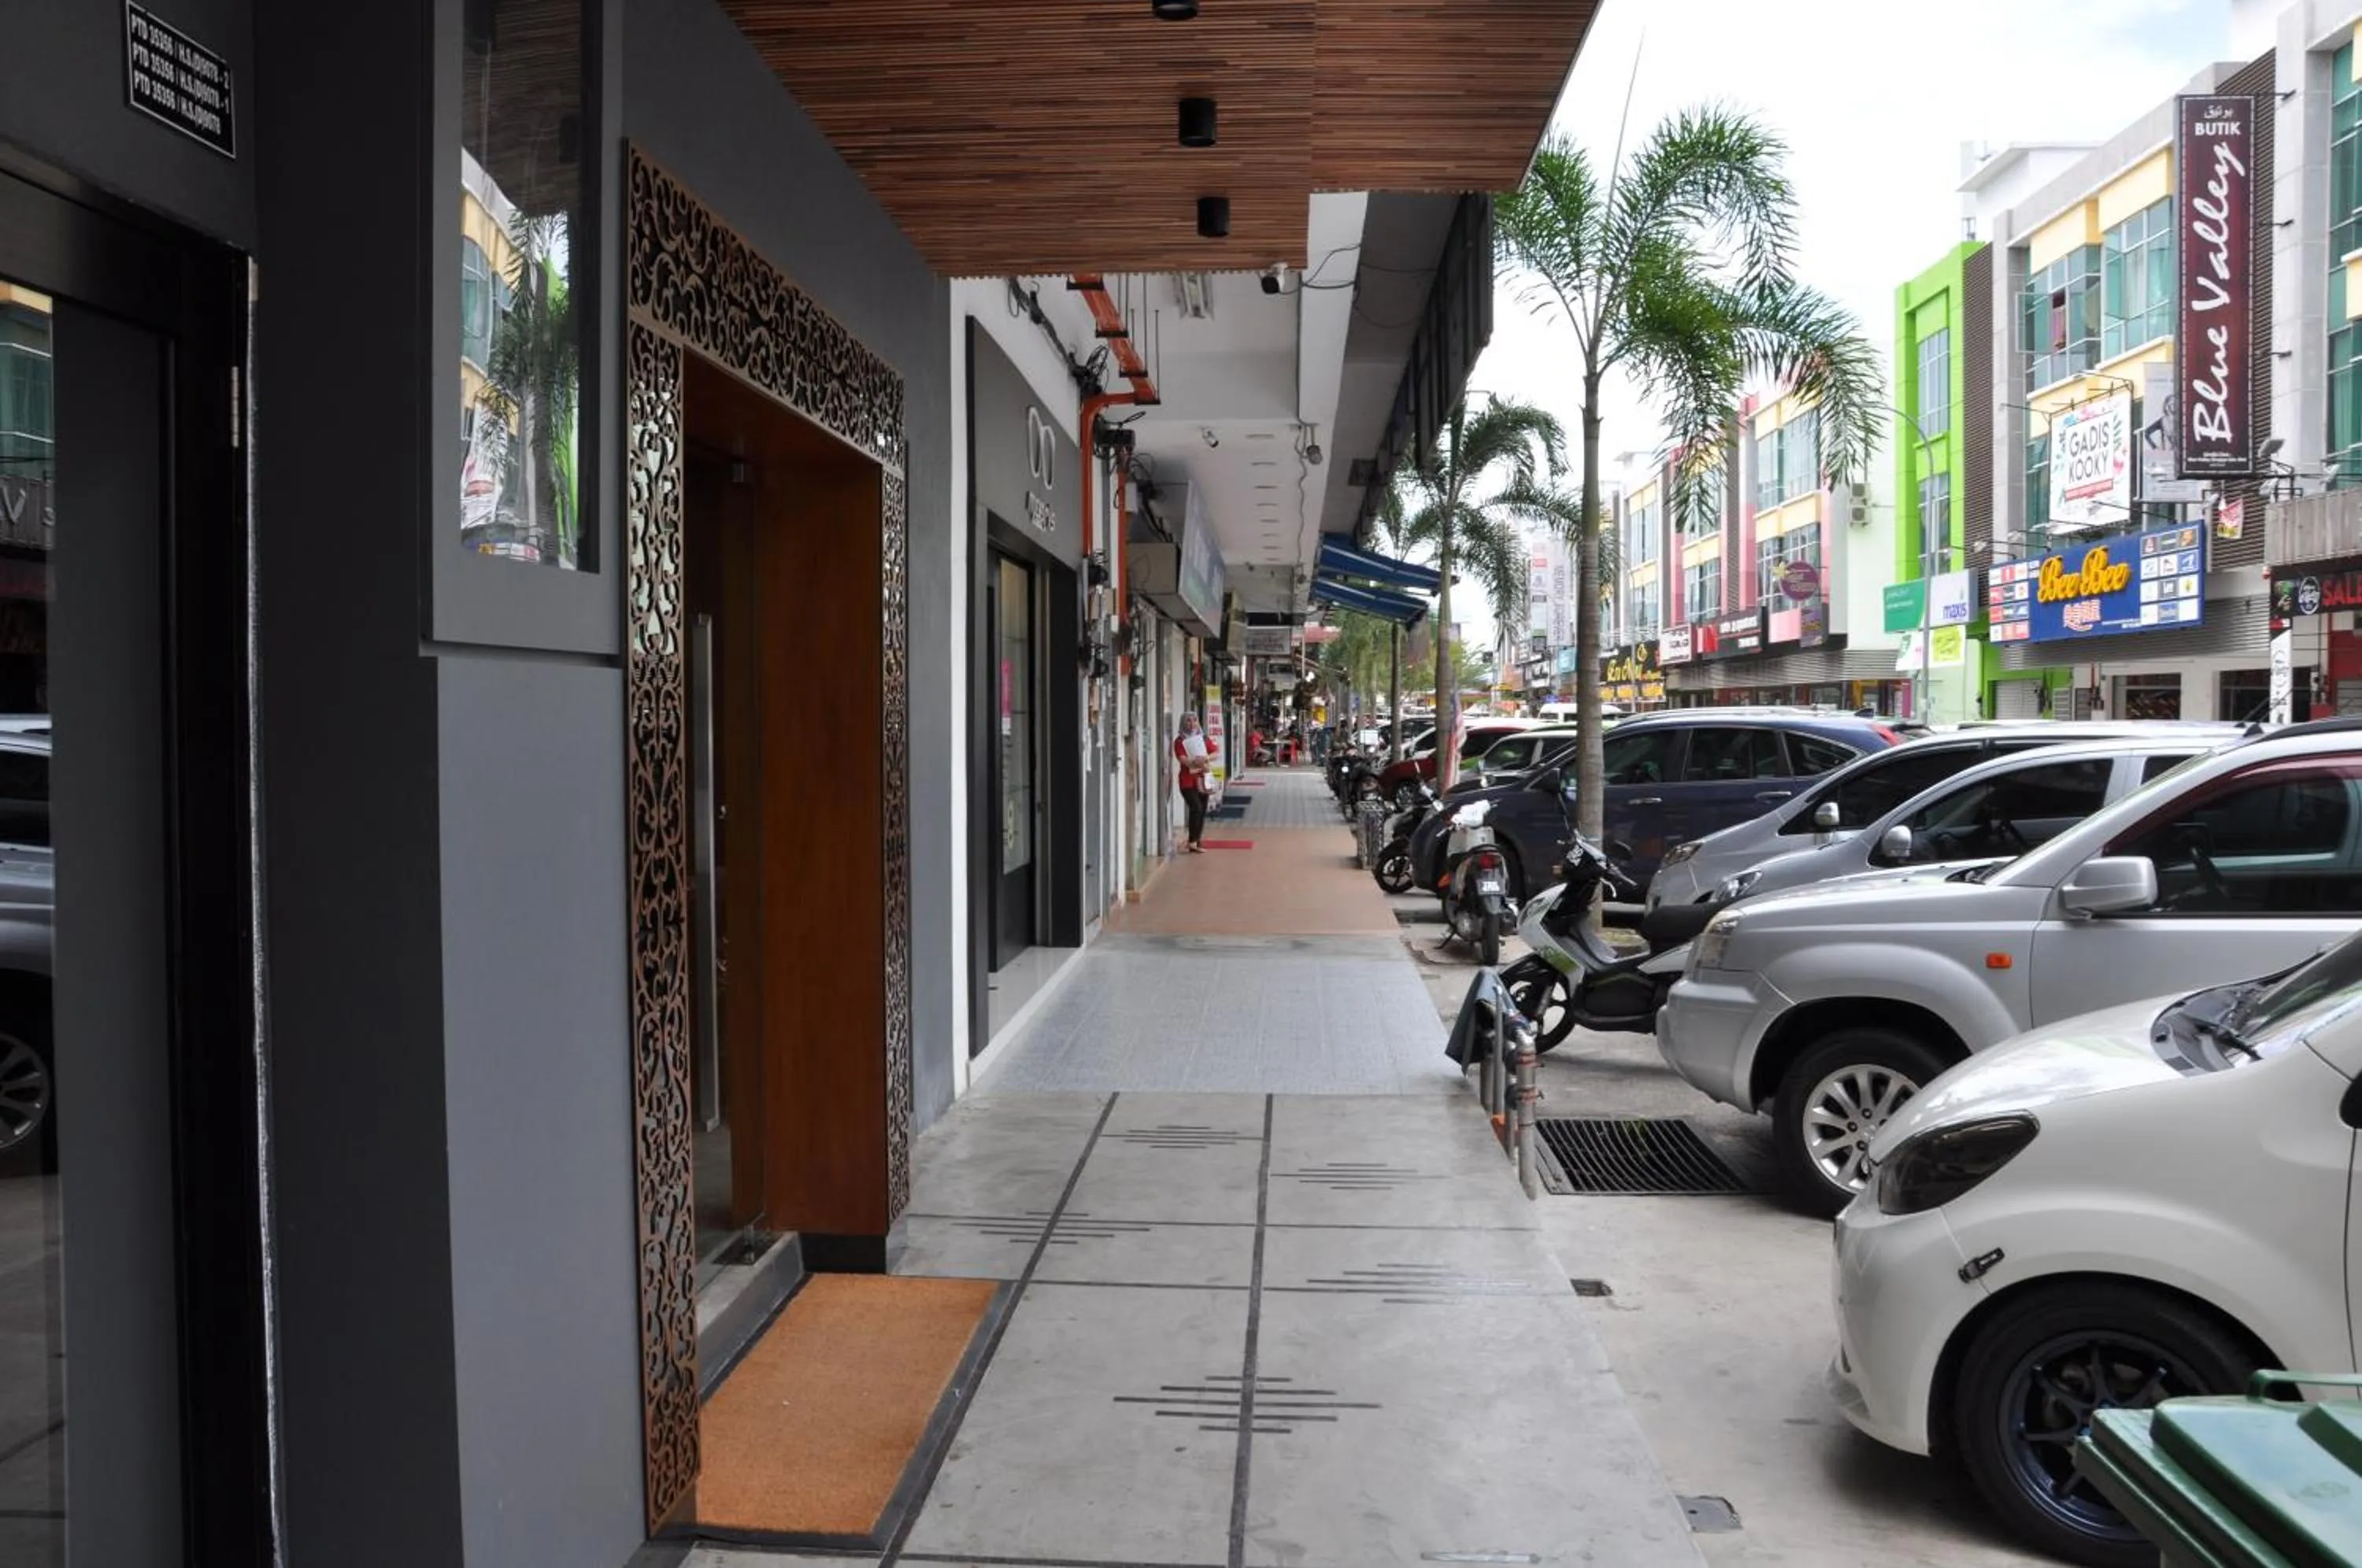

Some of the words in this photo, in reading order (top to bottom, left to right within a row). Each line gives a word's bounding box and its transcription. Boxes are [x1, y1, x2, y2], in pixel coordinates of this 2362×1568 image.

[131, 13, 148, 39] PTD
[132, 42, 149, 68] PTD
[134, 70, 150, 95] PTD
[2194, 121, 2241, 135] BUTIK
[2191, 141, 2245, 311] Valley
[2192, 325, 2232, 443] Blue
[2069, 421, 2109, 457] GADIS
[2068, 450, 2108, 483] KOOKY
[2037, 554, 2080, 604] Bee
[2079, 545, 2130, 596] Bee
[1942, 603, 1967, 619] maxis
